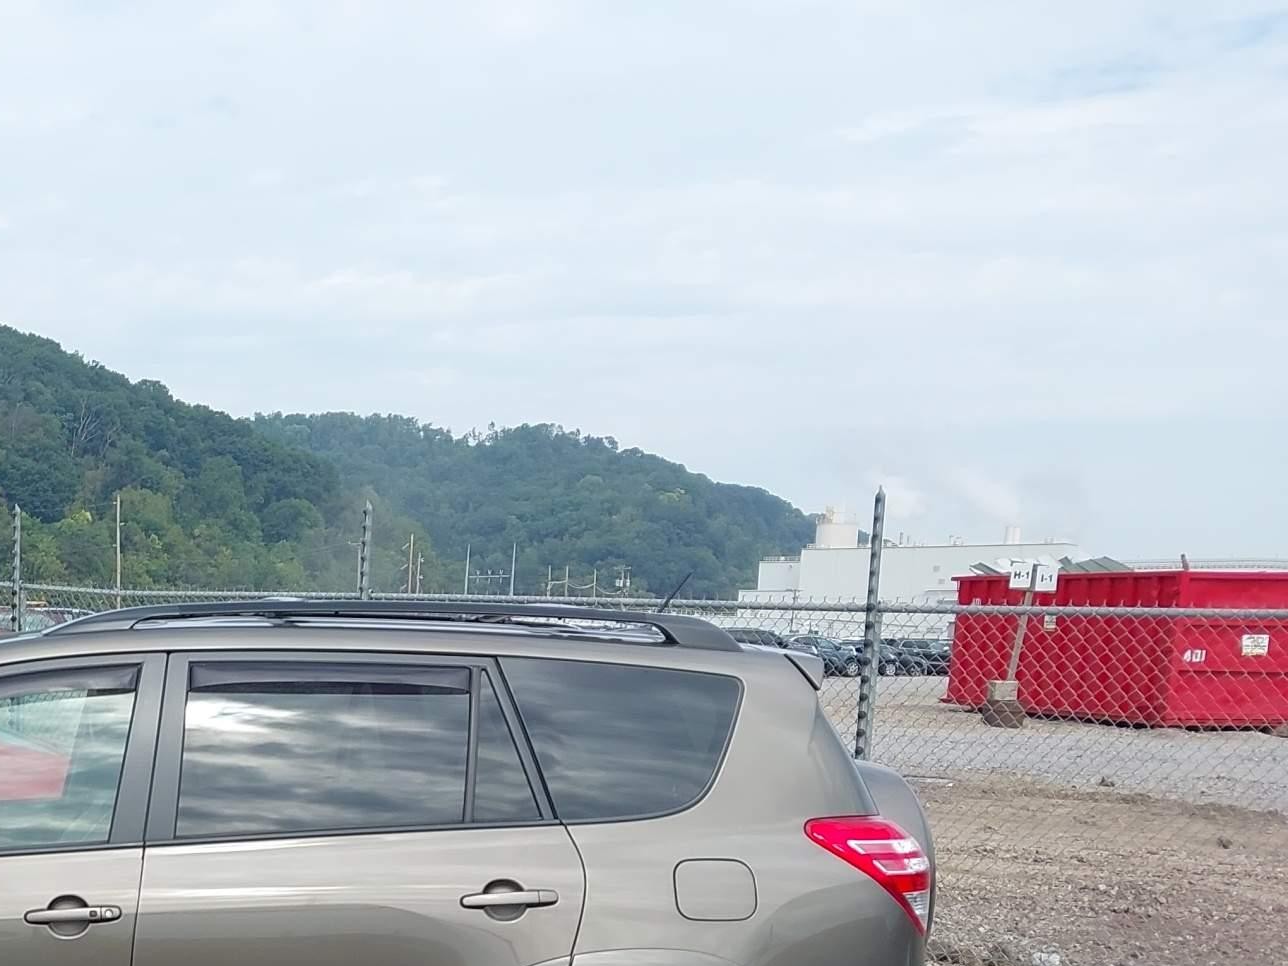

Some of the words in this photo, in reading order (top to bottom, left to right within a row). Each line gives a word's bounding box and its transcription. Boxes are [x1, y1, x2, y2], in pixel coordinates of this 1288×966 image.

[1013, 570, 1030, 580] H-1
[1040, 573, 1054, 583] I-1
[1183, 649, 1207, 662] 401
